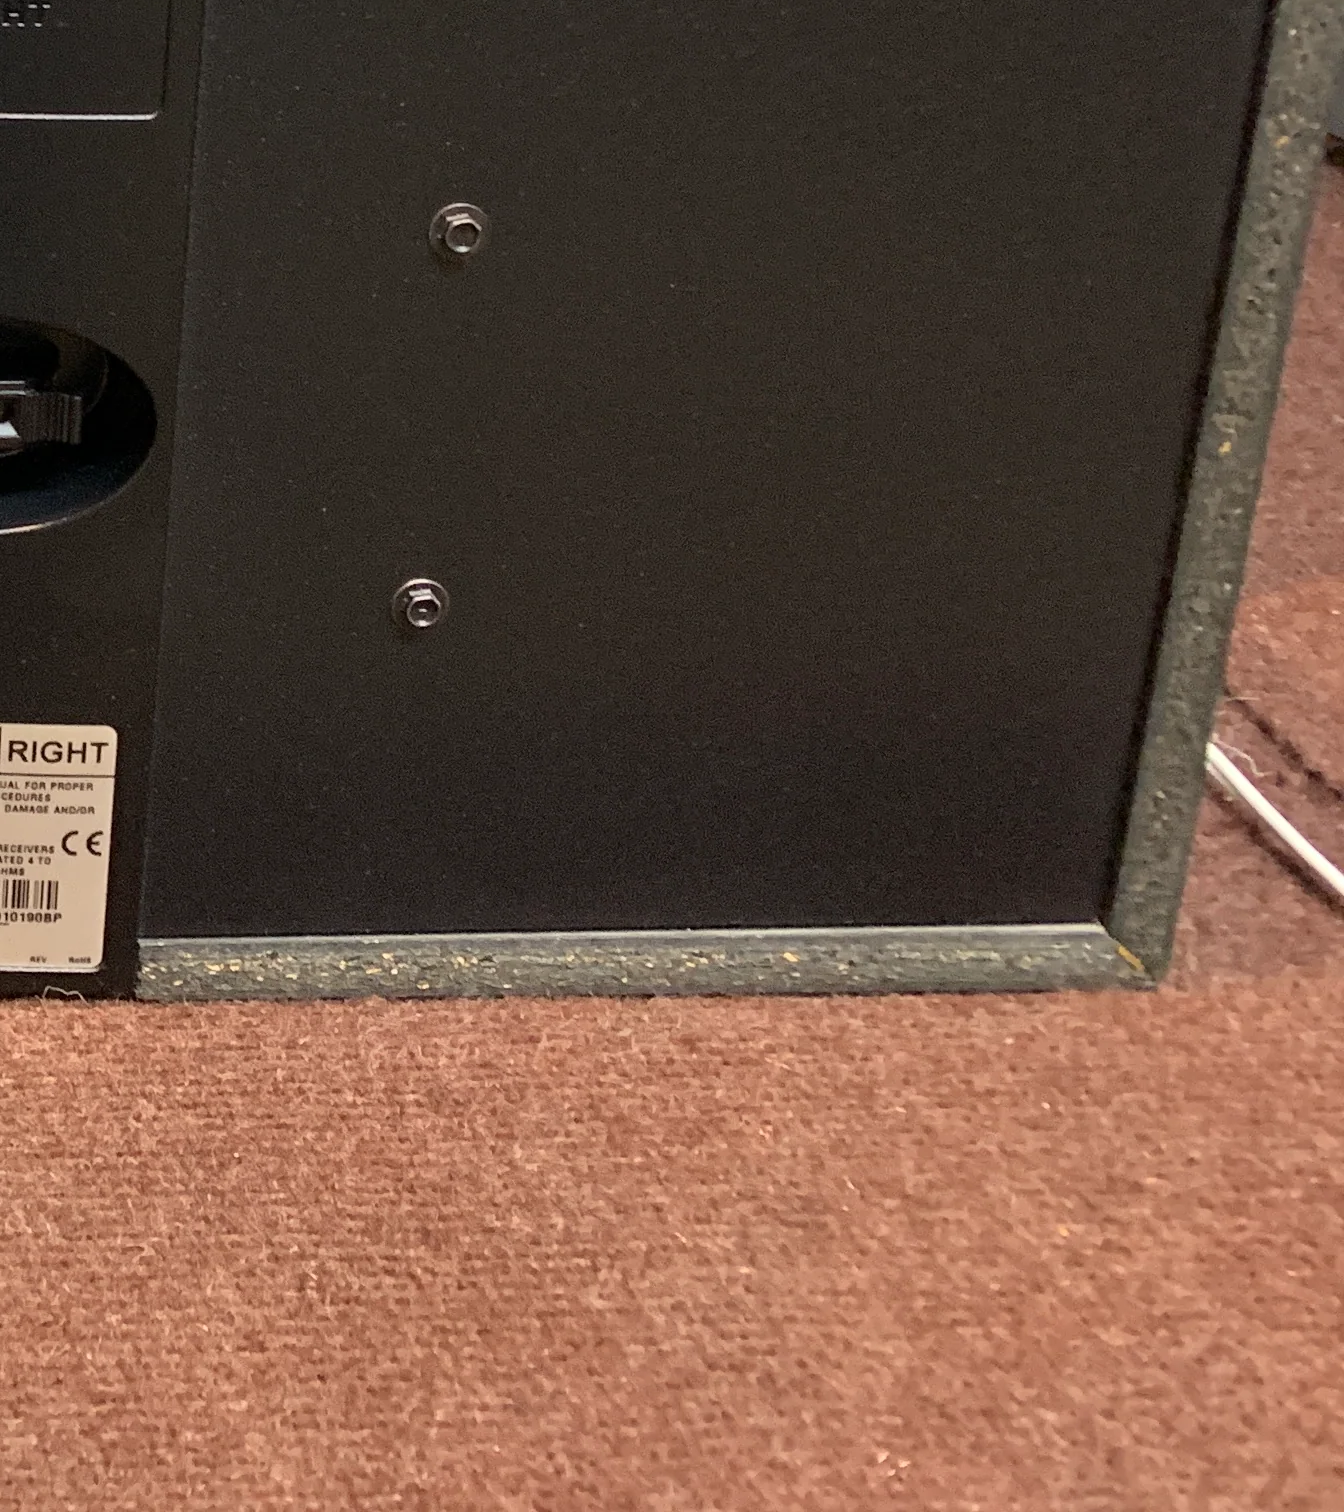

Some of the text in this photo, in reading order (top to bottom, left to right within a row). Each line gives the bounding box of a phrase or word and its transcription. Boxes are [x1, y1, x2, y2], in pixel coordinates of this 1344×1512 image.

[8, 740, 109, 764] RIGHT
[25, 781, 46, 790] FOR
[50, 782, 94, 791] PROPER
[5, 804, 49, 814] DAMAGE
[54, 806, 96, 815] AND/OR
[38, 856, 51, 865] TO
